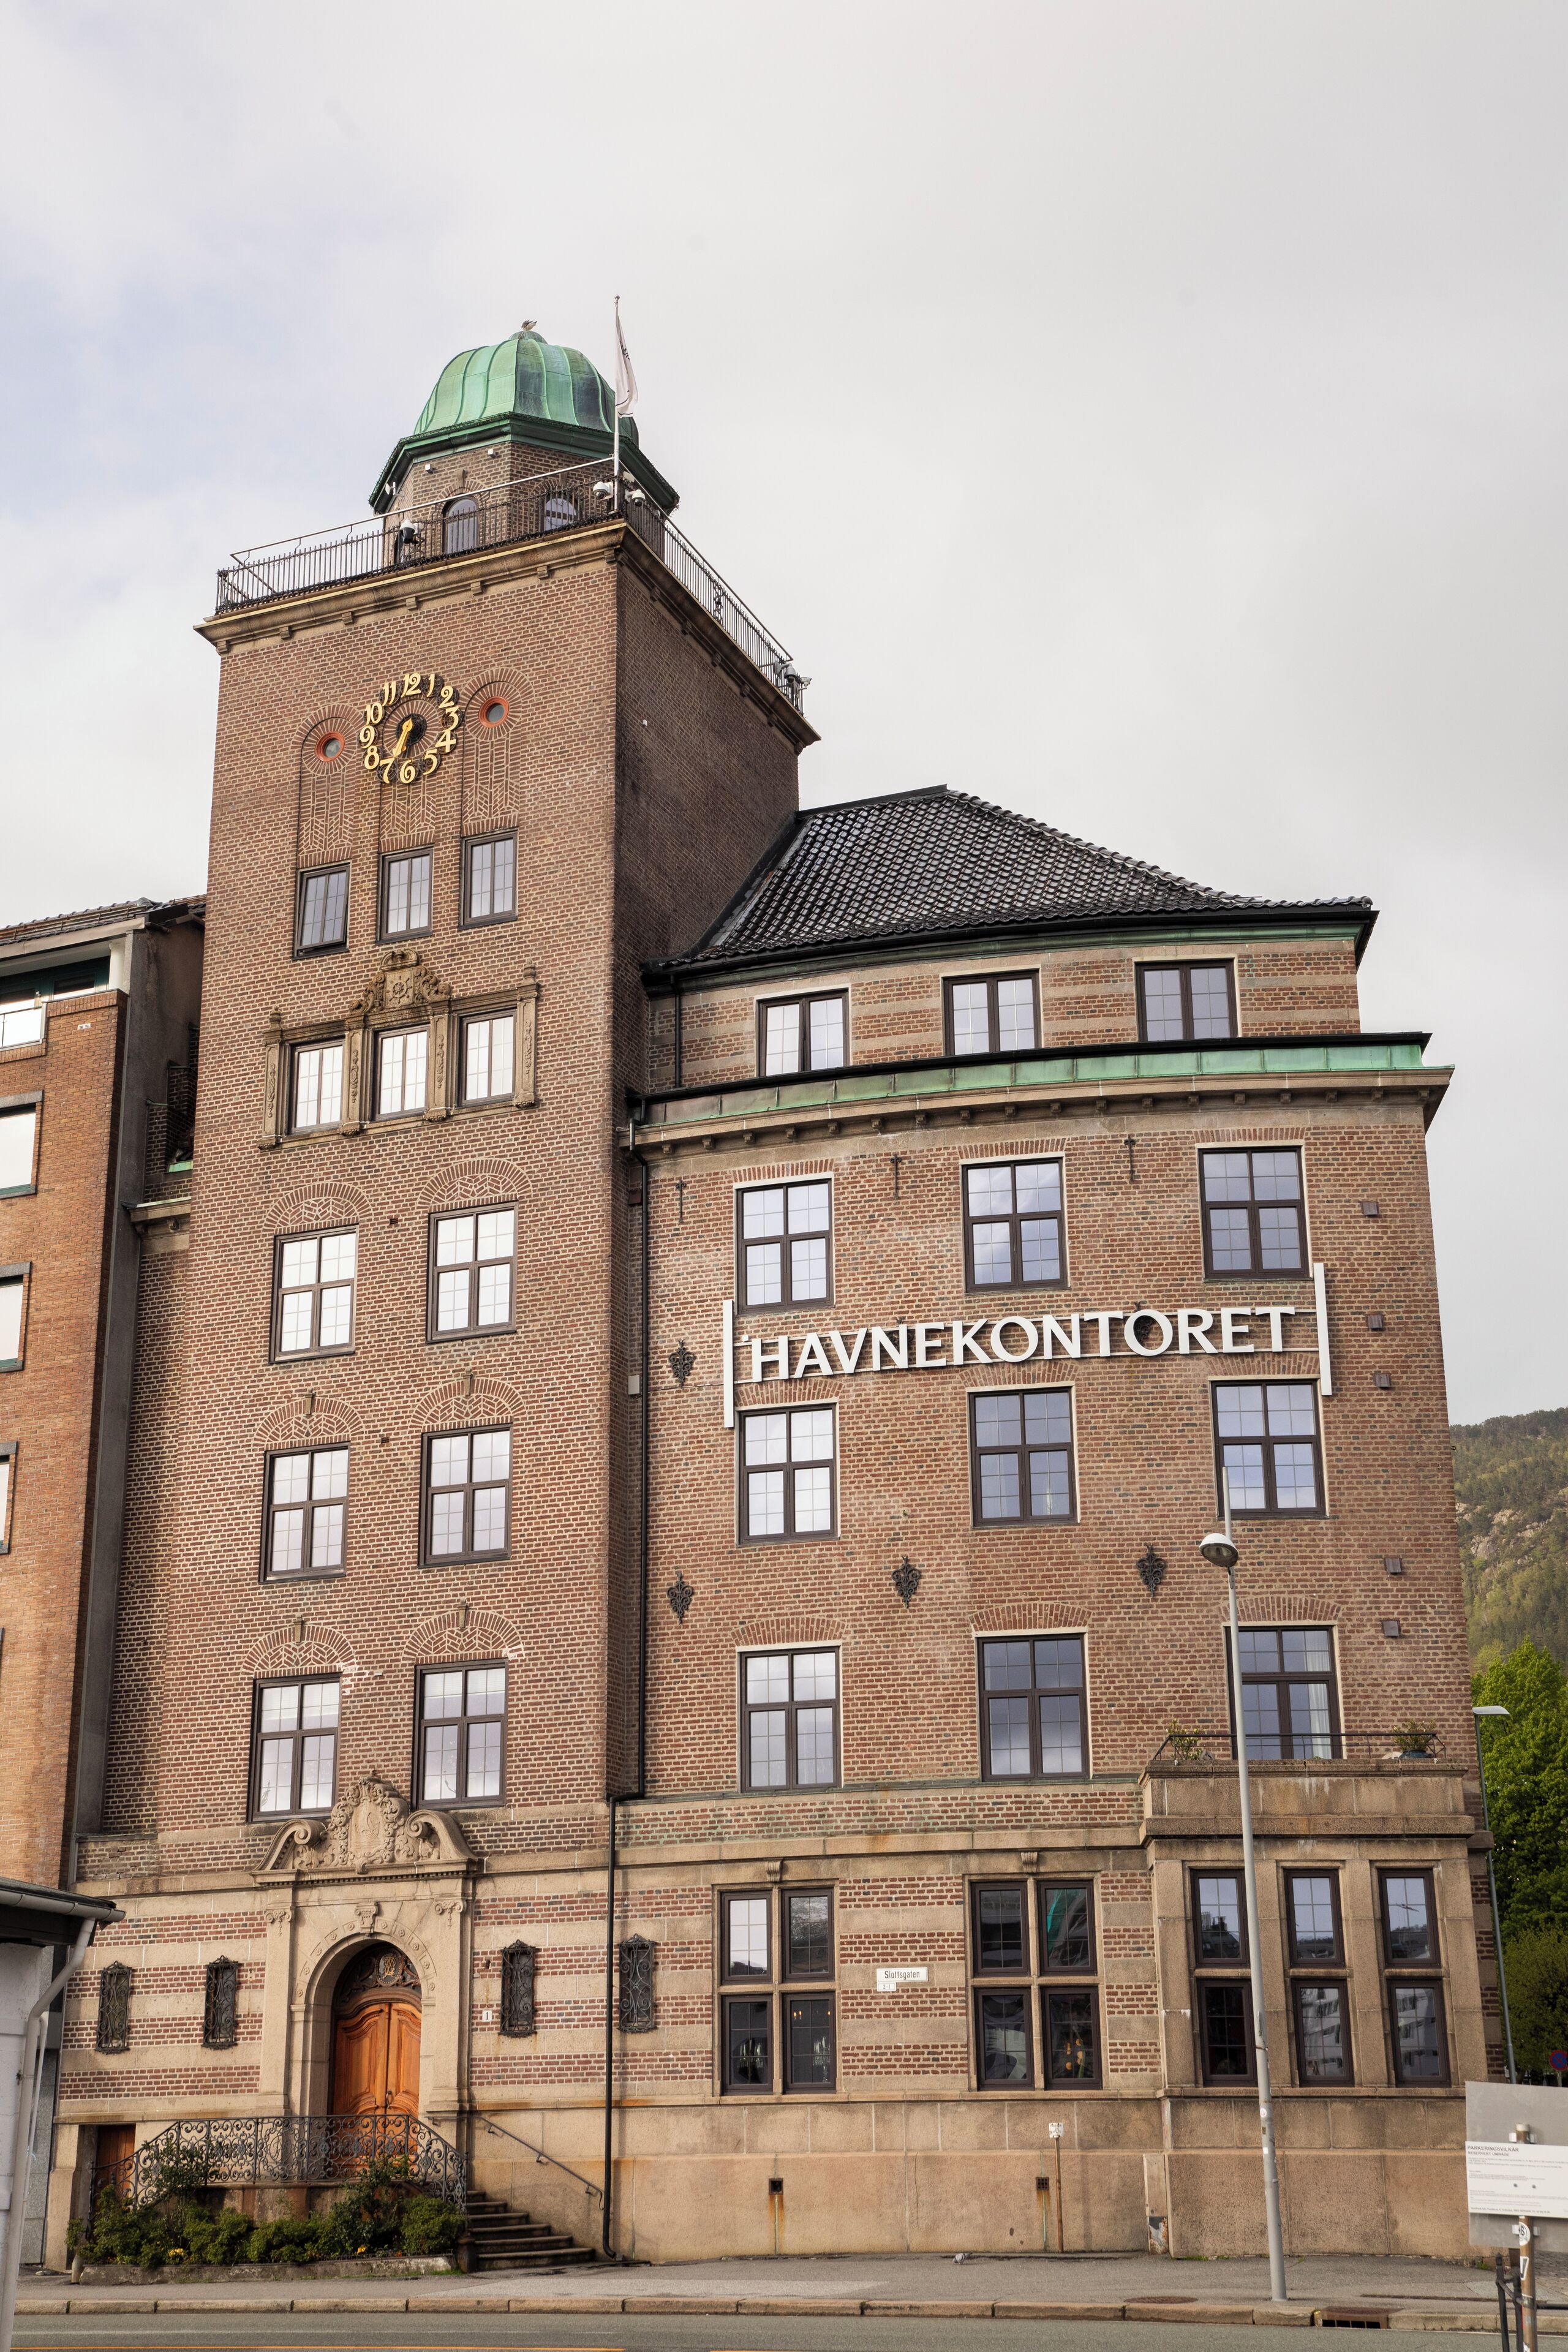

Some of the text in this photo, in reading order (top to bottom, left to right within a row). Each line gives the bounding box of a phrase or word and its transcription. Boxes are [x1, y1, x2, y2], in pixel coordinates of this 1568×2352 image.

[382, 681, 396, 706] 11
[401, 673, 421, 698] 12
[426, 674, 435, 697] 1
[439, 686, 454, 708] 2
[366, 703, 382, 725] 10
[445, 706, 459, 731] 3
[360, 726, 375, 748] 9
[435, 730, 456, 752] 4
[364, 745, 379, 769] 8
[423, 749, 437, 775] 5
[380, 758, 394, 783] 7
[400, 760, 415, 783] 6
[752, 1306, 1295, 1382] HAVNEKONTORET
[884, 1970, 920, 1980] Slottsgaten
